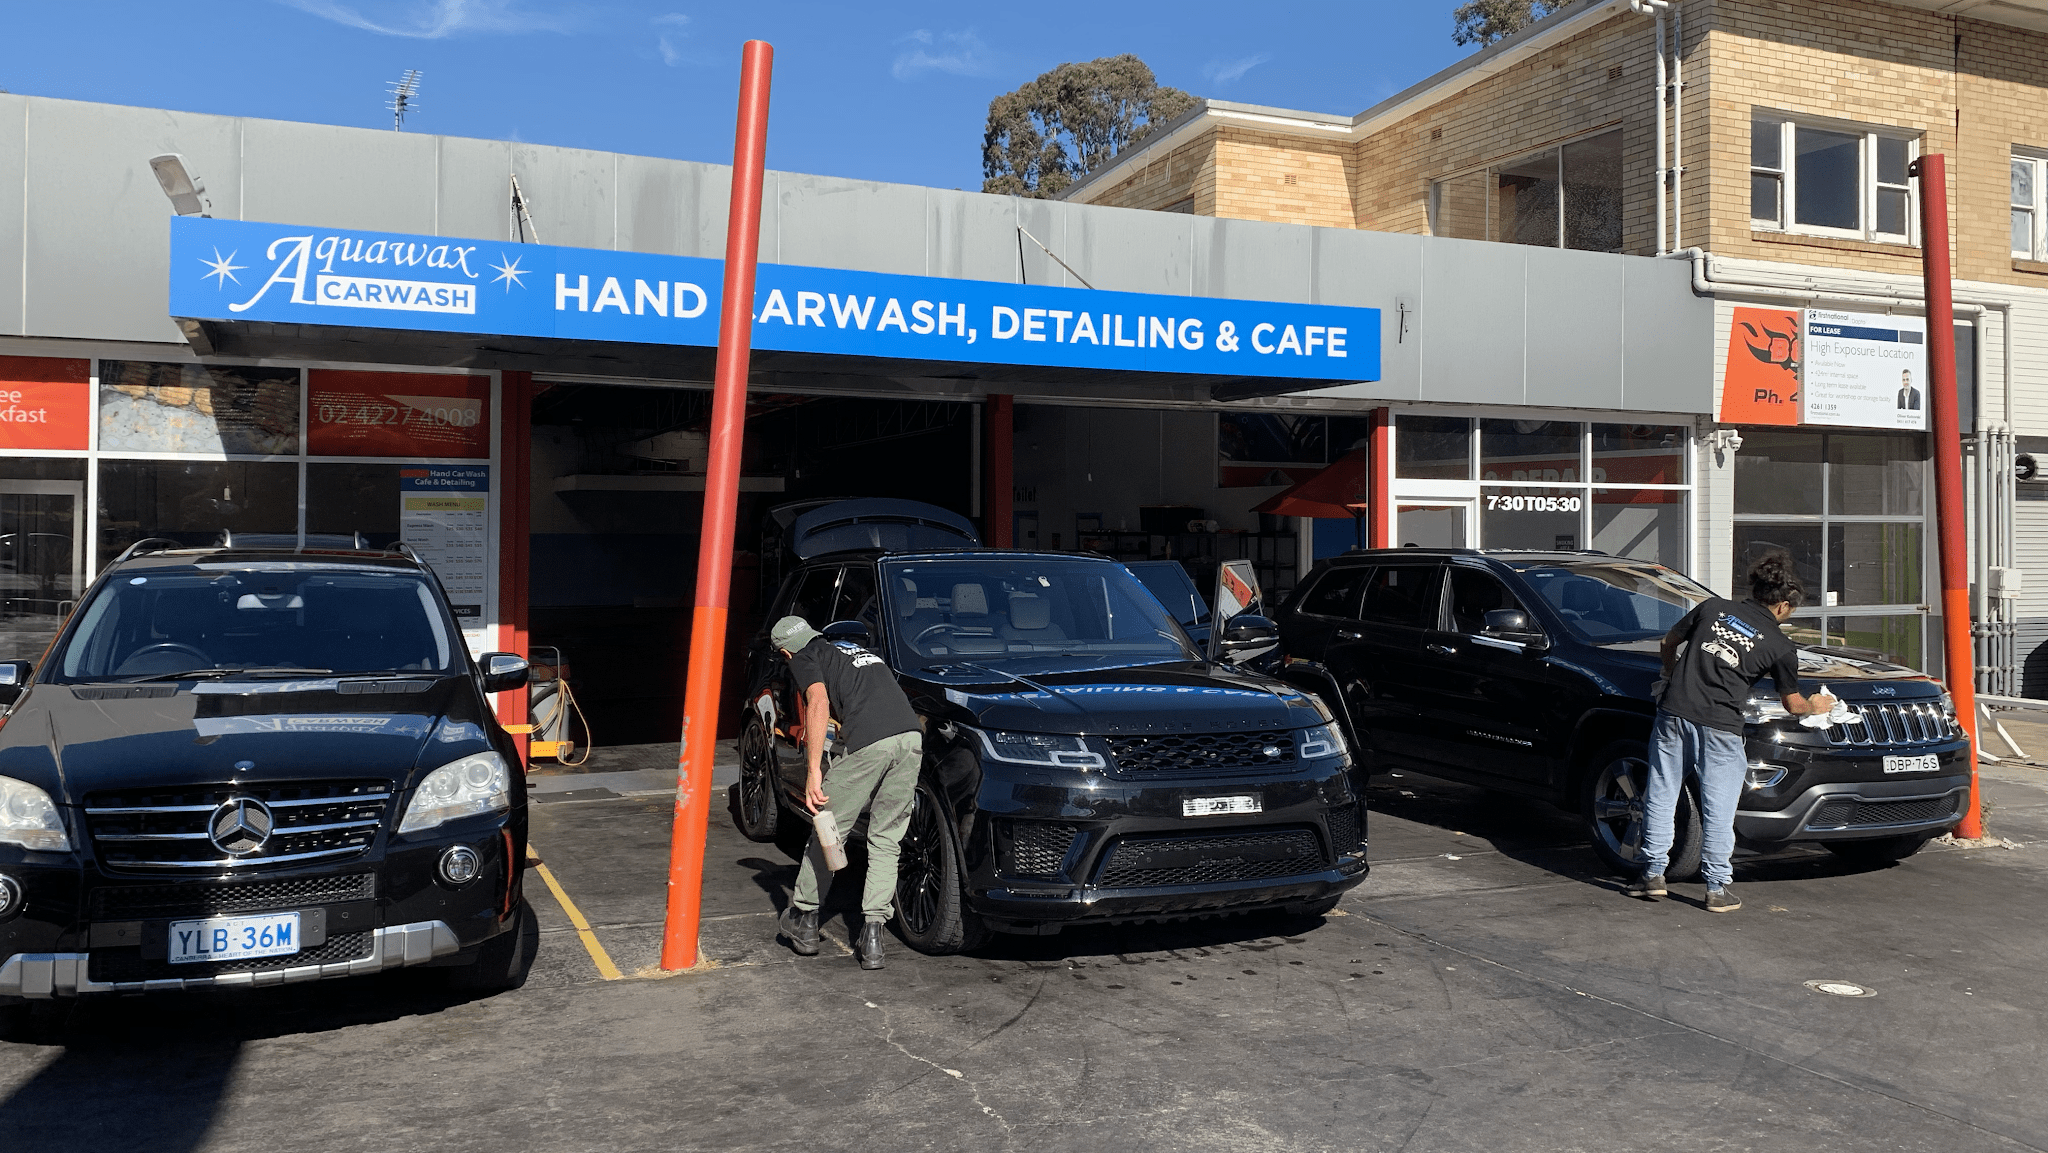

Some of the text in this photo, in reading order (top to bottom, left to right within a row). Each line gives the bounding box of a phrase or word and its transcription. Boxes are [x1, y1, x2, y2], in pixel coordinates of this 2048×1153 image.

[229, 234, 479, 312] Aquawax
[323, 281, 471, 309] CARWASH
[555, 273, 1348, 358] HAND ARWASH, DETAILING & CAFE
[1823, 327, 1841, 335] LEASE
[1810, 340, 1914, 359] High Exposure Location
[1754, 389, 1782, 404] Ph.
[319, 404, 476, 427] 02 4227 4008
[452, 470, 465, 478] Car
[465, 470, 486, 478] Wash
[1512, 467, 1608, 495] REPAR
[414, 478, 432, 486] Cafe
[440, 479, 475, 488] Detailing
[1872, 685, 1896, 696] Jeep
[175, 954, 212, 962] CANBERRA
[218, 951, 241, 959] HEART
[269, 946, 293, 954] NATION
